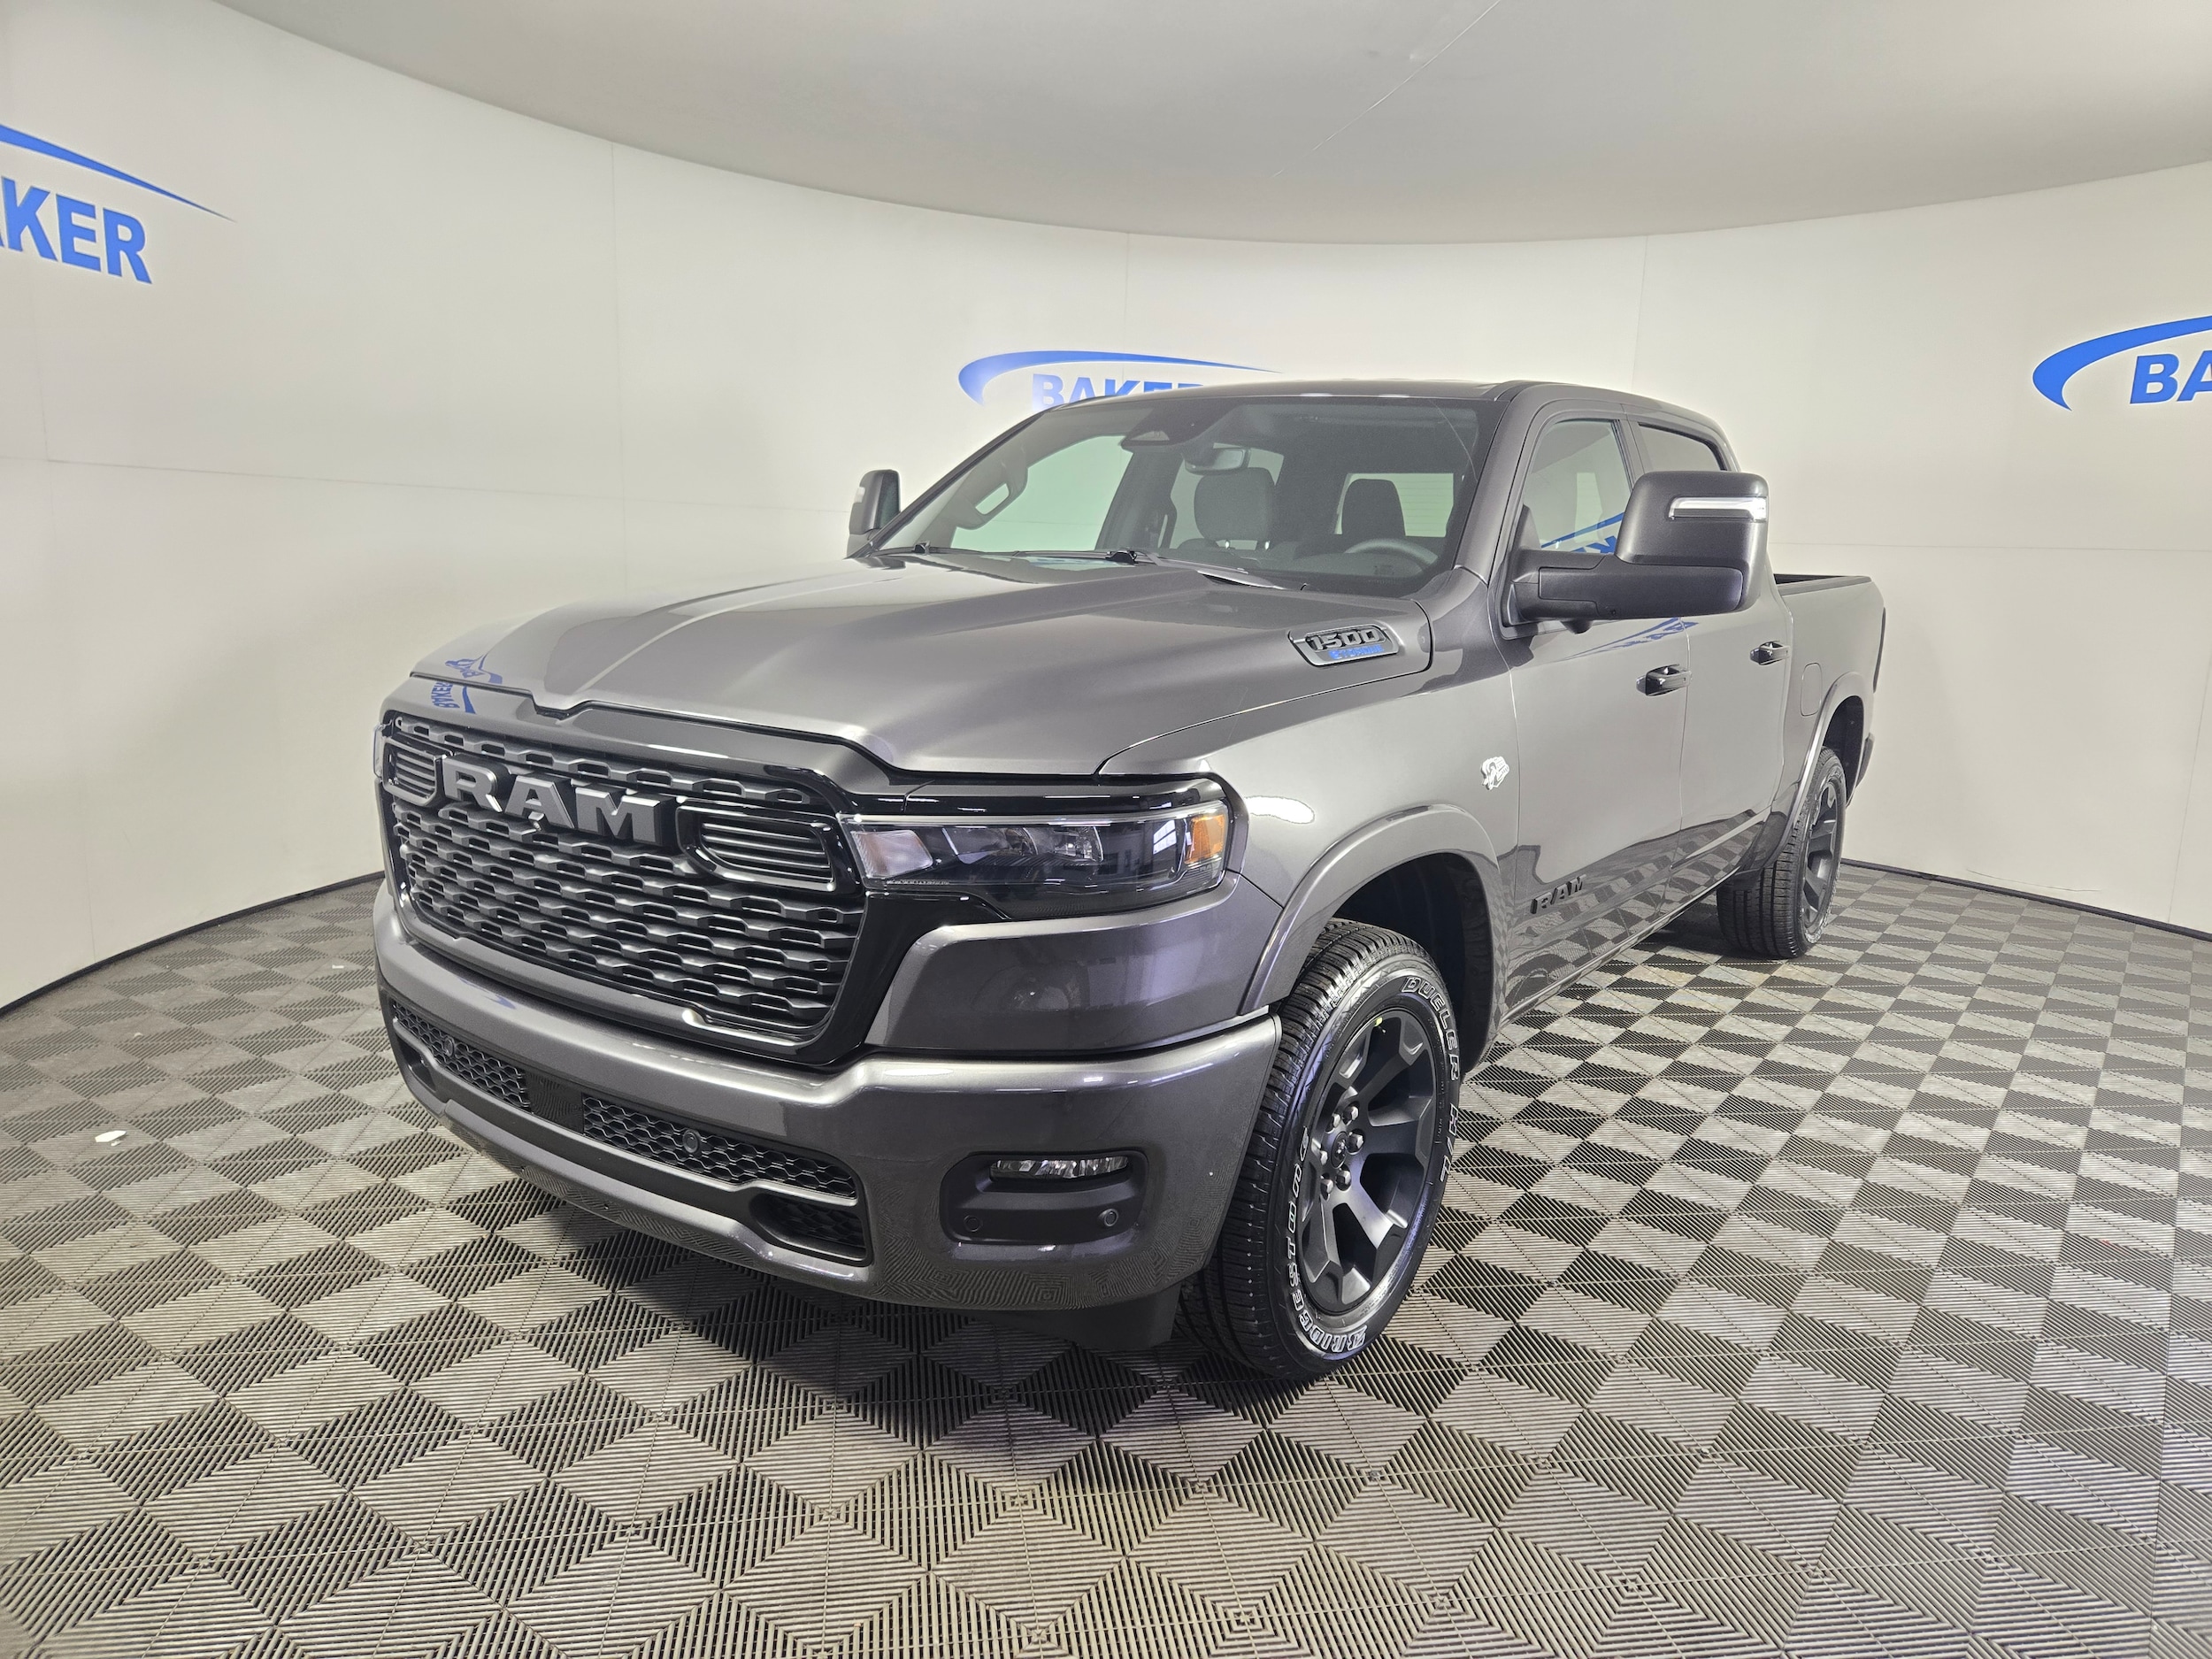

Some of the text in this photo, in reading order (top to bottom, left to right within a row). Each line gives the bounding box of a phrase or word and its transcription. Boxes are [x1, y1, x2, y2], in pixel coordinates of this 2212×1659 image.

[0, 176, 152, 284] KER
[1308, 628, 1381, 650] 1500
[442, 755, 665, 843] RAM
[1530, 874, 1586, 914] RAM
[1401, 976, 1460, 1081] DUELER
[1286, 1125, 1368, 1353] BRIDGESTONE
